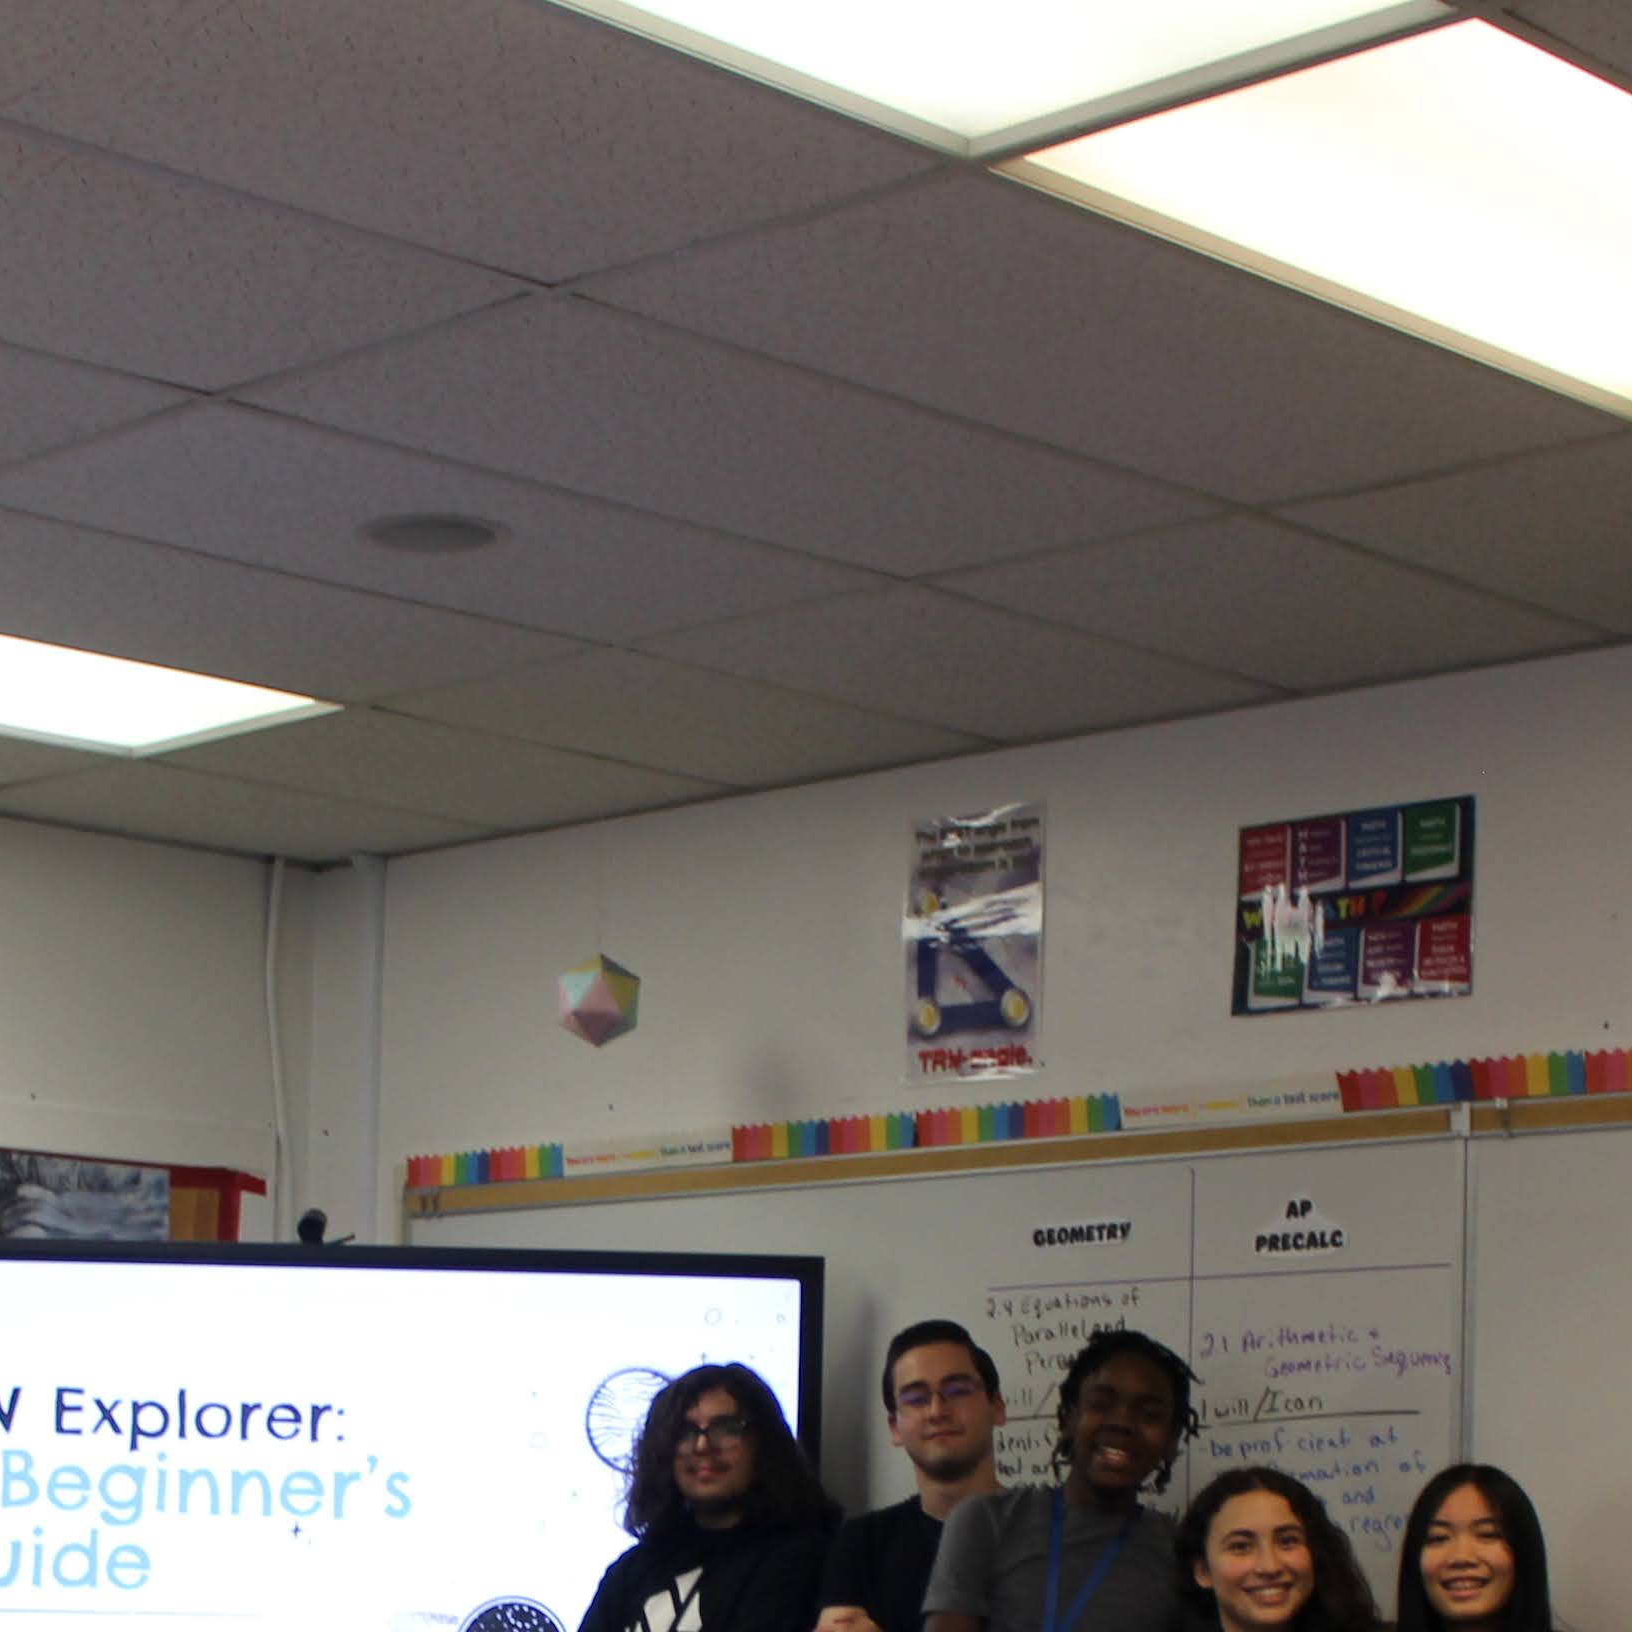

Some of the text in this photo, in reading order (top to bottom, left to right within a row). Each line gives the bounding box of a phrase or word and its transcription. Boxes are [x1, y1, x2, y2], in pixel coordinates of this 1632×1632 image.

[1286, 1199, 1312, 1220] AP
[1033, 1221, 1132, 1247] GEOMETRY
[1255, 1229, 1344, 1252] PRECALC
[54, 1386, 346, 1453] Explorer:
[0, 1447, 413, 1527] Beginner's
